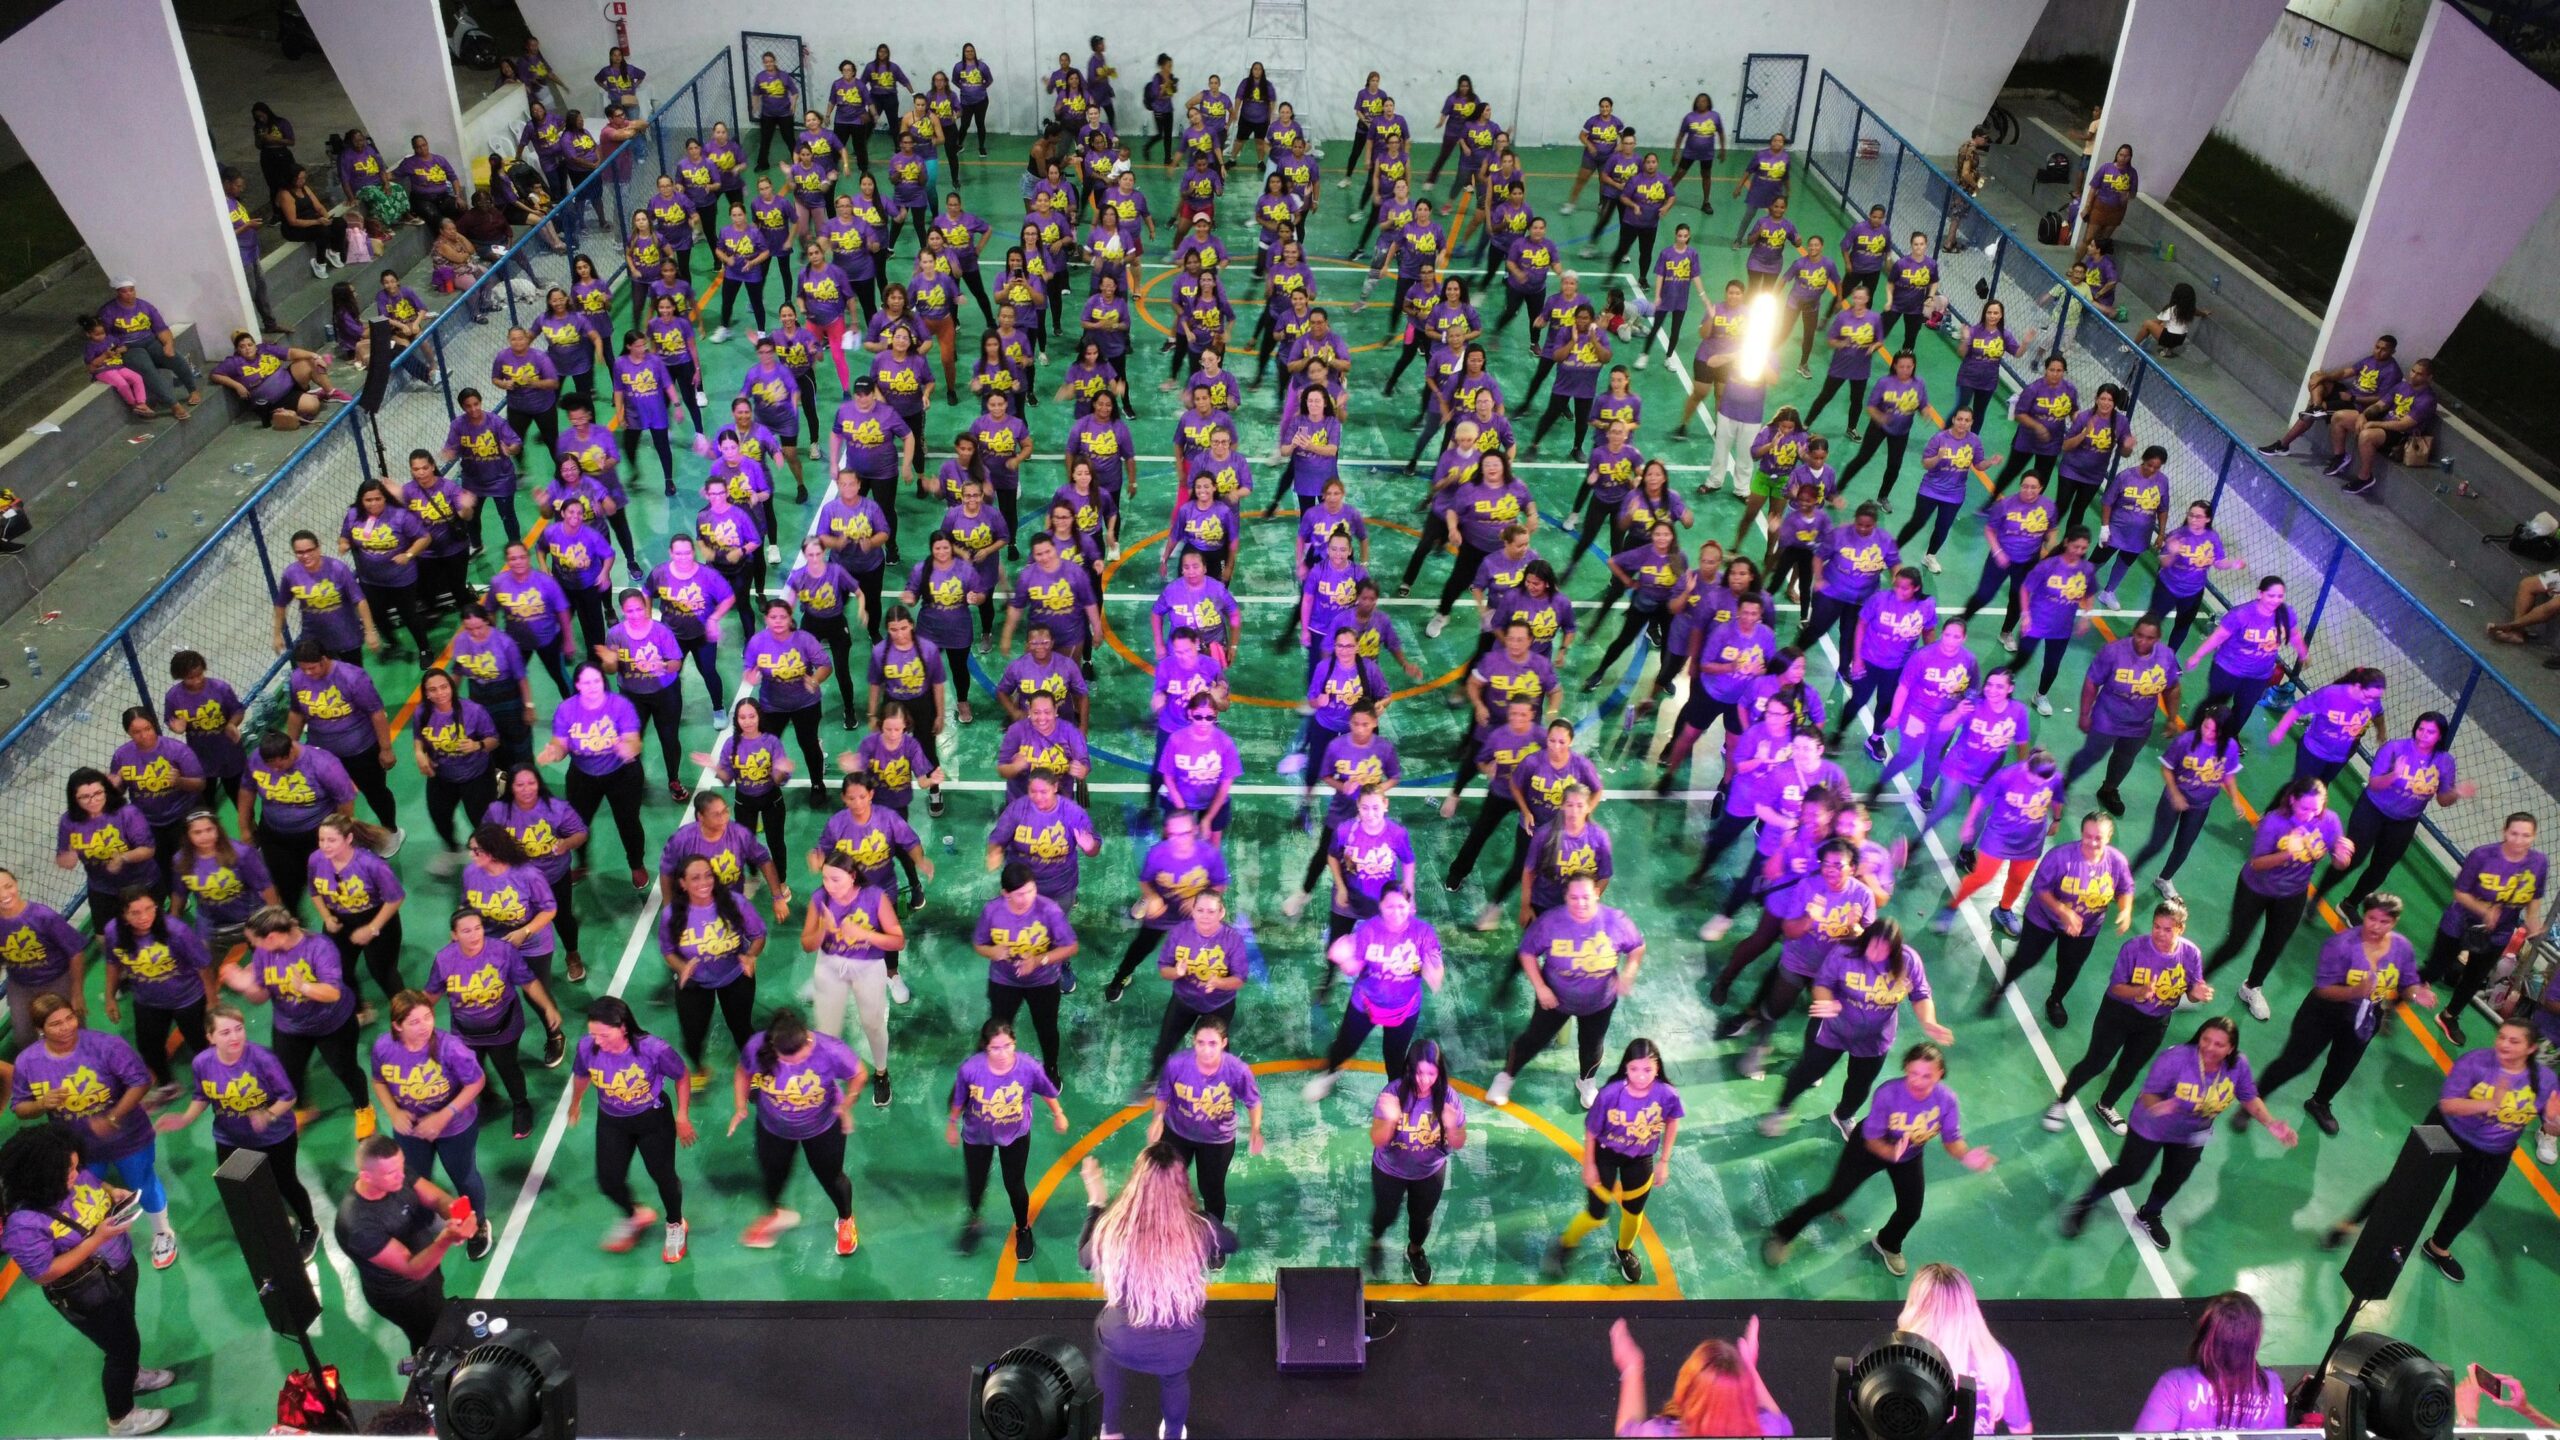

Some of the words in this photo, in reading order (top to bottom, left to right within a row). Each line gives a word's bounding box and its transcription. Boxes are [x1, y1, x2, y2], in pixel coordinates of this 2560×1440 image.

[757, 653, 788, 669] ELA
[2115, 669, 2148, 685] ELA
[1014, 823, 1049, 844] ELA
[2061, 876, 2099, 897] ELA
[467, 889, 503, 909] ELA
[990, 928, 1028, 948] ELA
[446, 975, 485, 994] ELA
[1846, 971, 1889, 994] ELA
[381, 1064, 424, 1085] ELA
[202, 1079, 238, 1100] ELA
